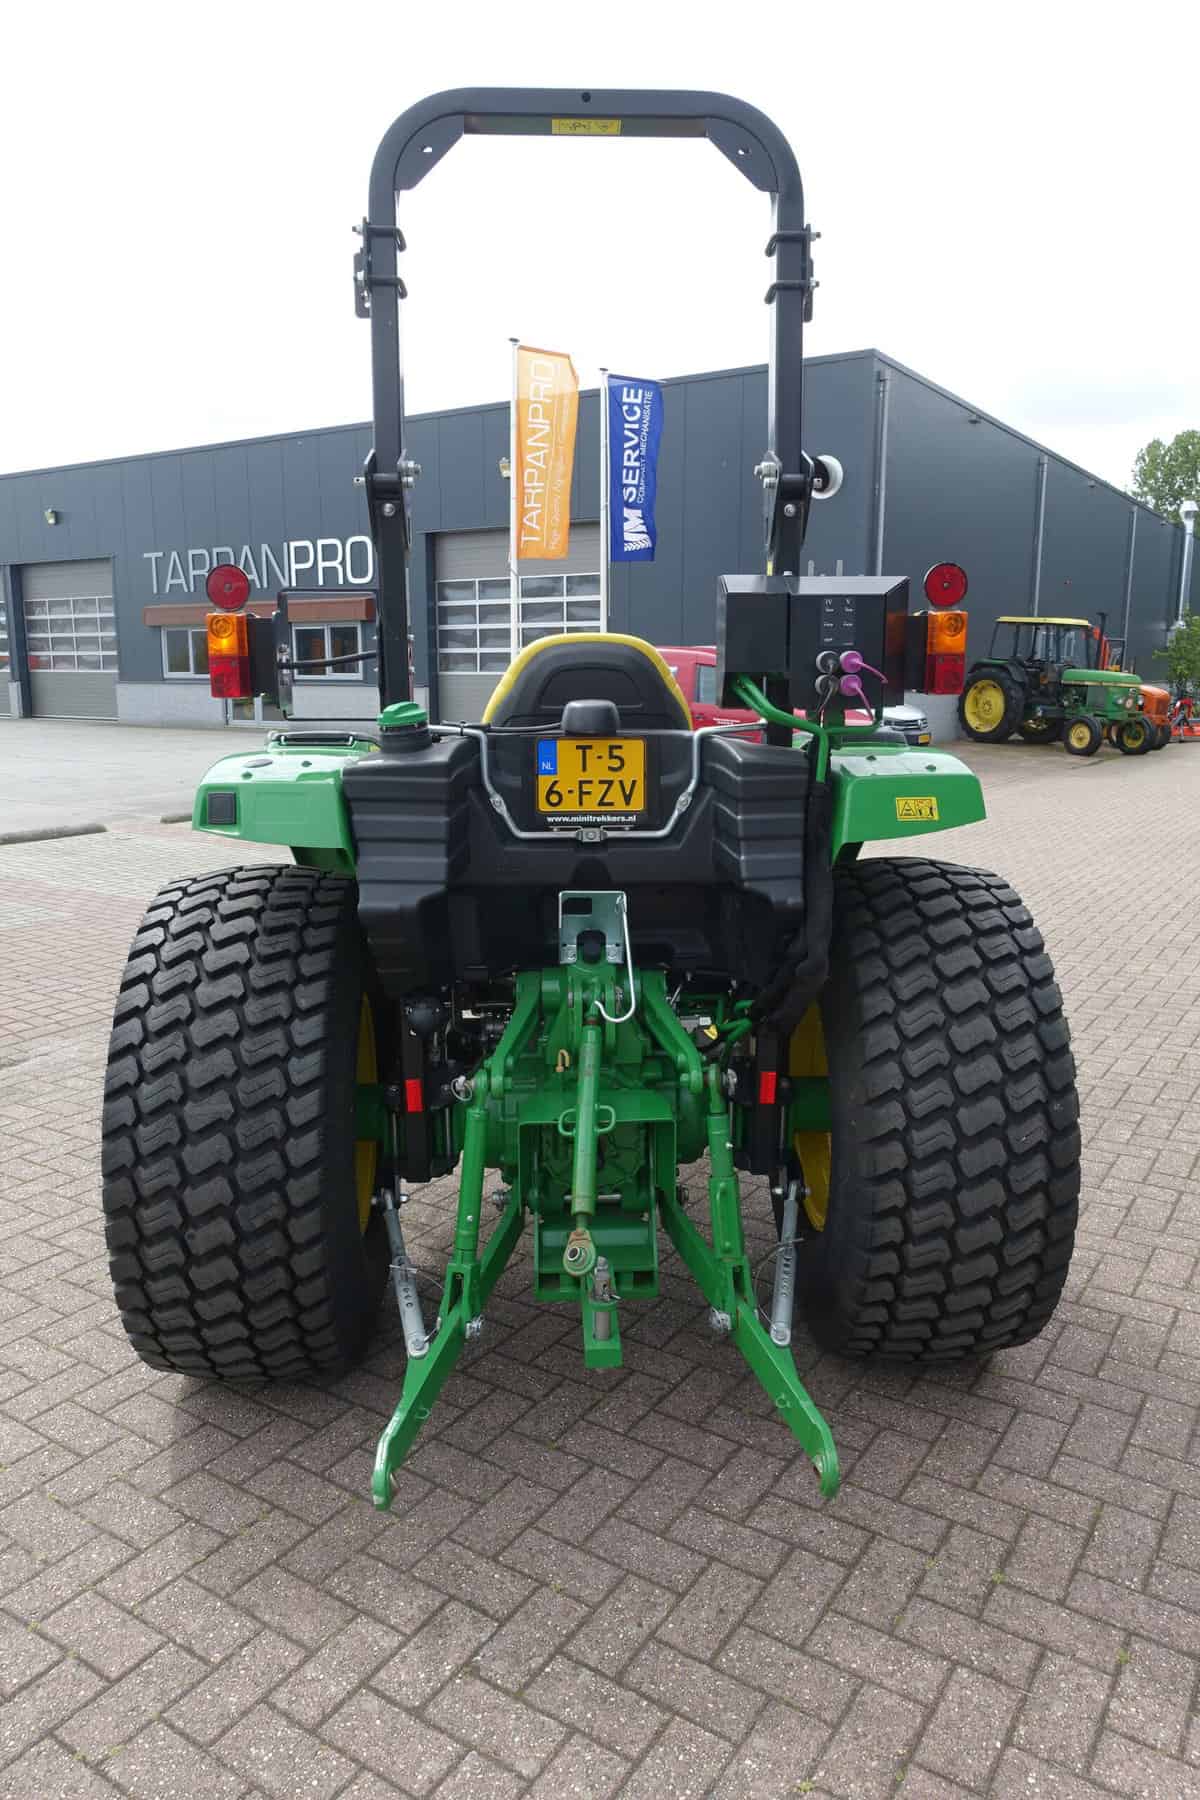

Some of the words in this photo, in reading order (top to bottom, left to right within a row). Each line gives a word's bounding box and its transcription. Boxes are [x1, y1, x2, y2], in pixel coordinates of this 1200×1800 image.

[520, 358, 556, 549] TARPANPRO
[622, 386, 643, 504] SERVICE
[541, 761, 554, 770] NL
[575, 744, 626, 773] T-5
[545, 780, 637, 808] 6-FZV
